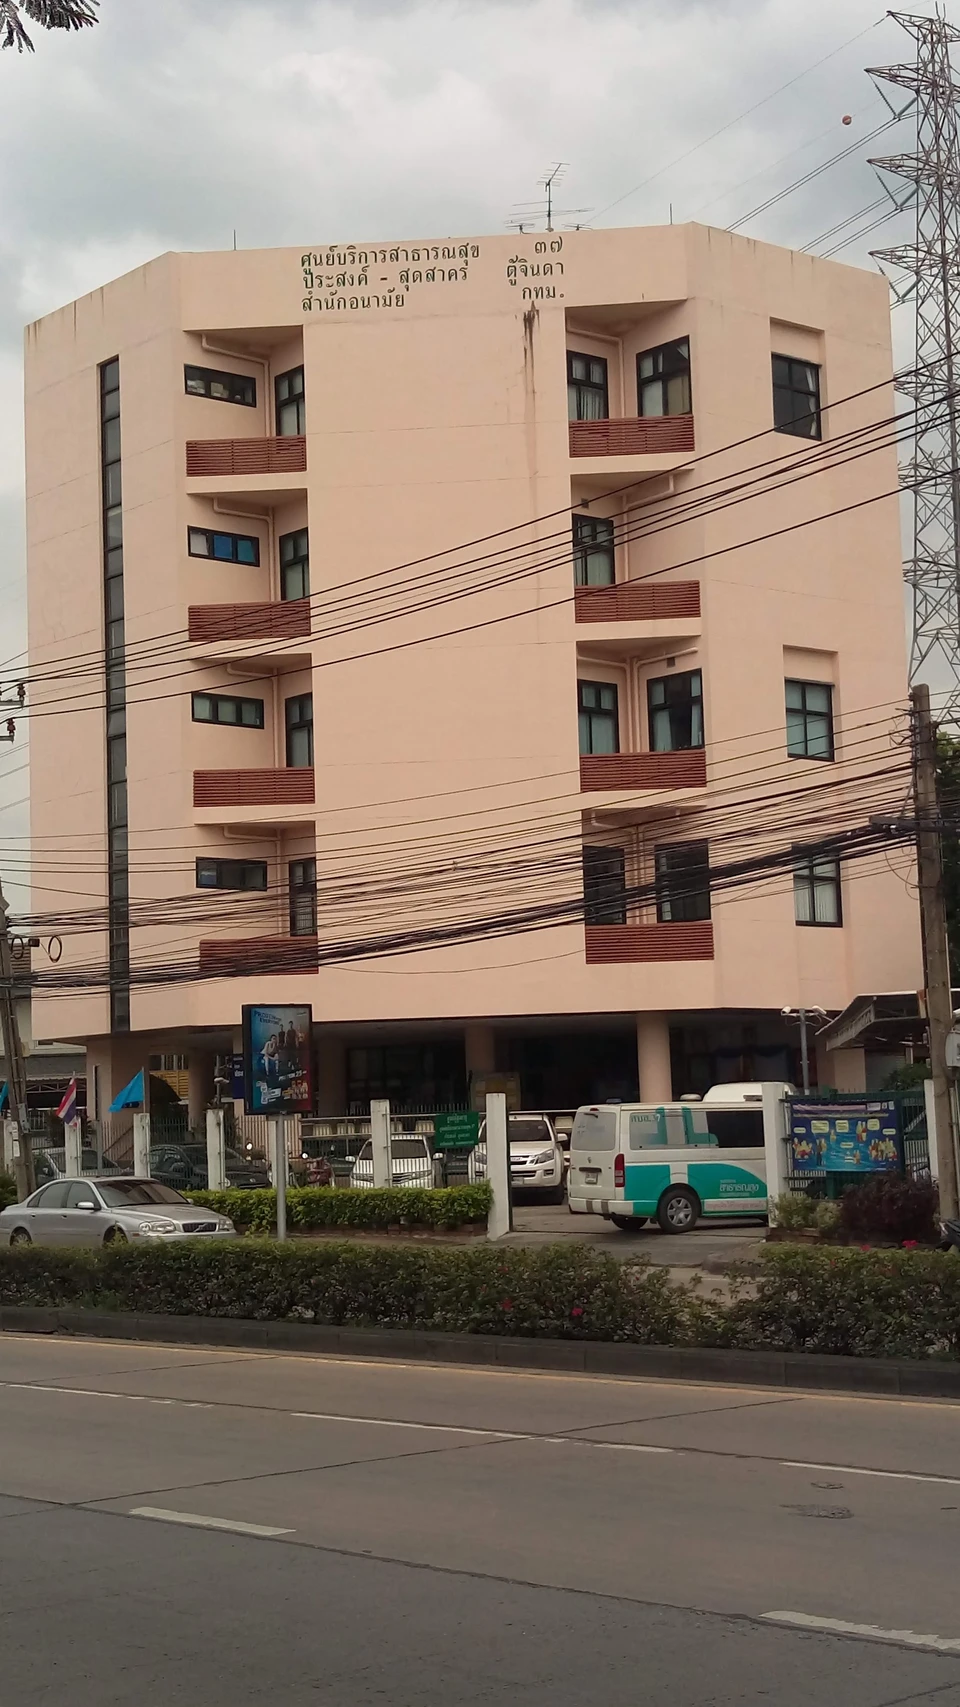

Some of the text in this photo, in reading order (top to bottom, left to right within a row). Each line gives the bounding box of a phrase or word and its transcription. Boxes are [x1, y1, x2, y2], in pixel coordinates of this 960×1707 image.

[301, 236, 563, 274] ศูนย์บริการสาธารณสุข ๓๗
[303, 265, 370, 289] ประสงค์
[399, 266, 468, 292] สุดสาคร
[507, 255, 564, 286] ตู้จินดา
[301, 286, 564, 311] สำนักอนามัย กทม.
